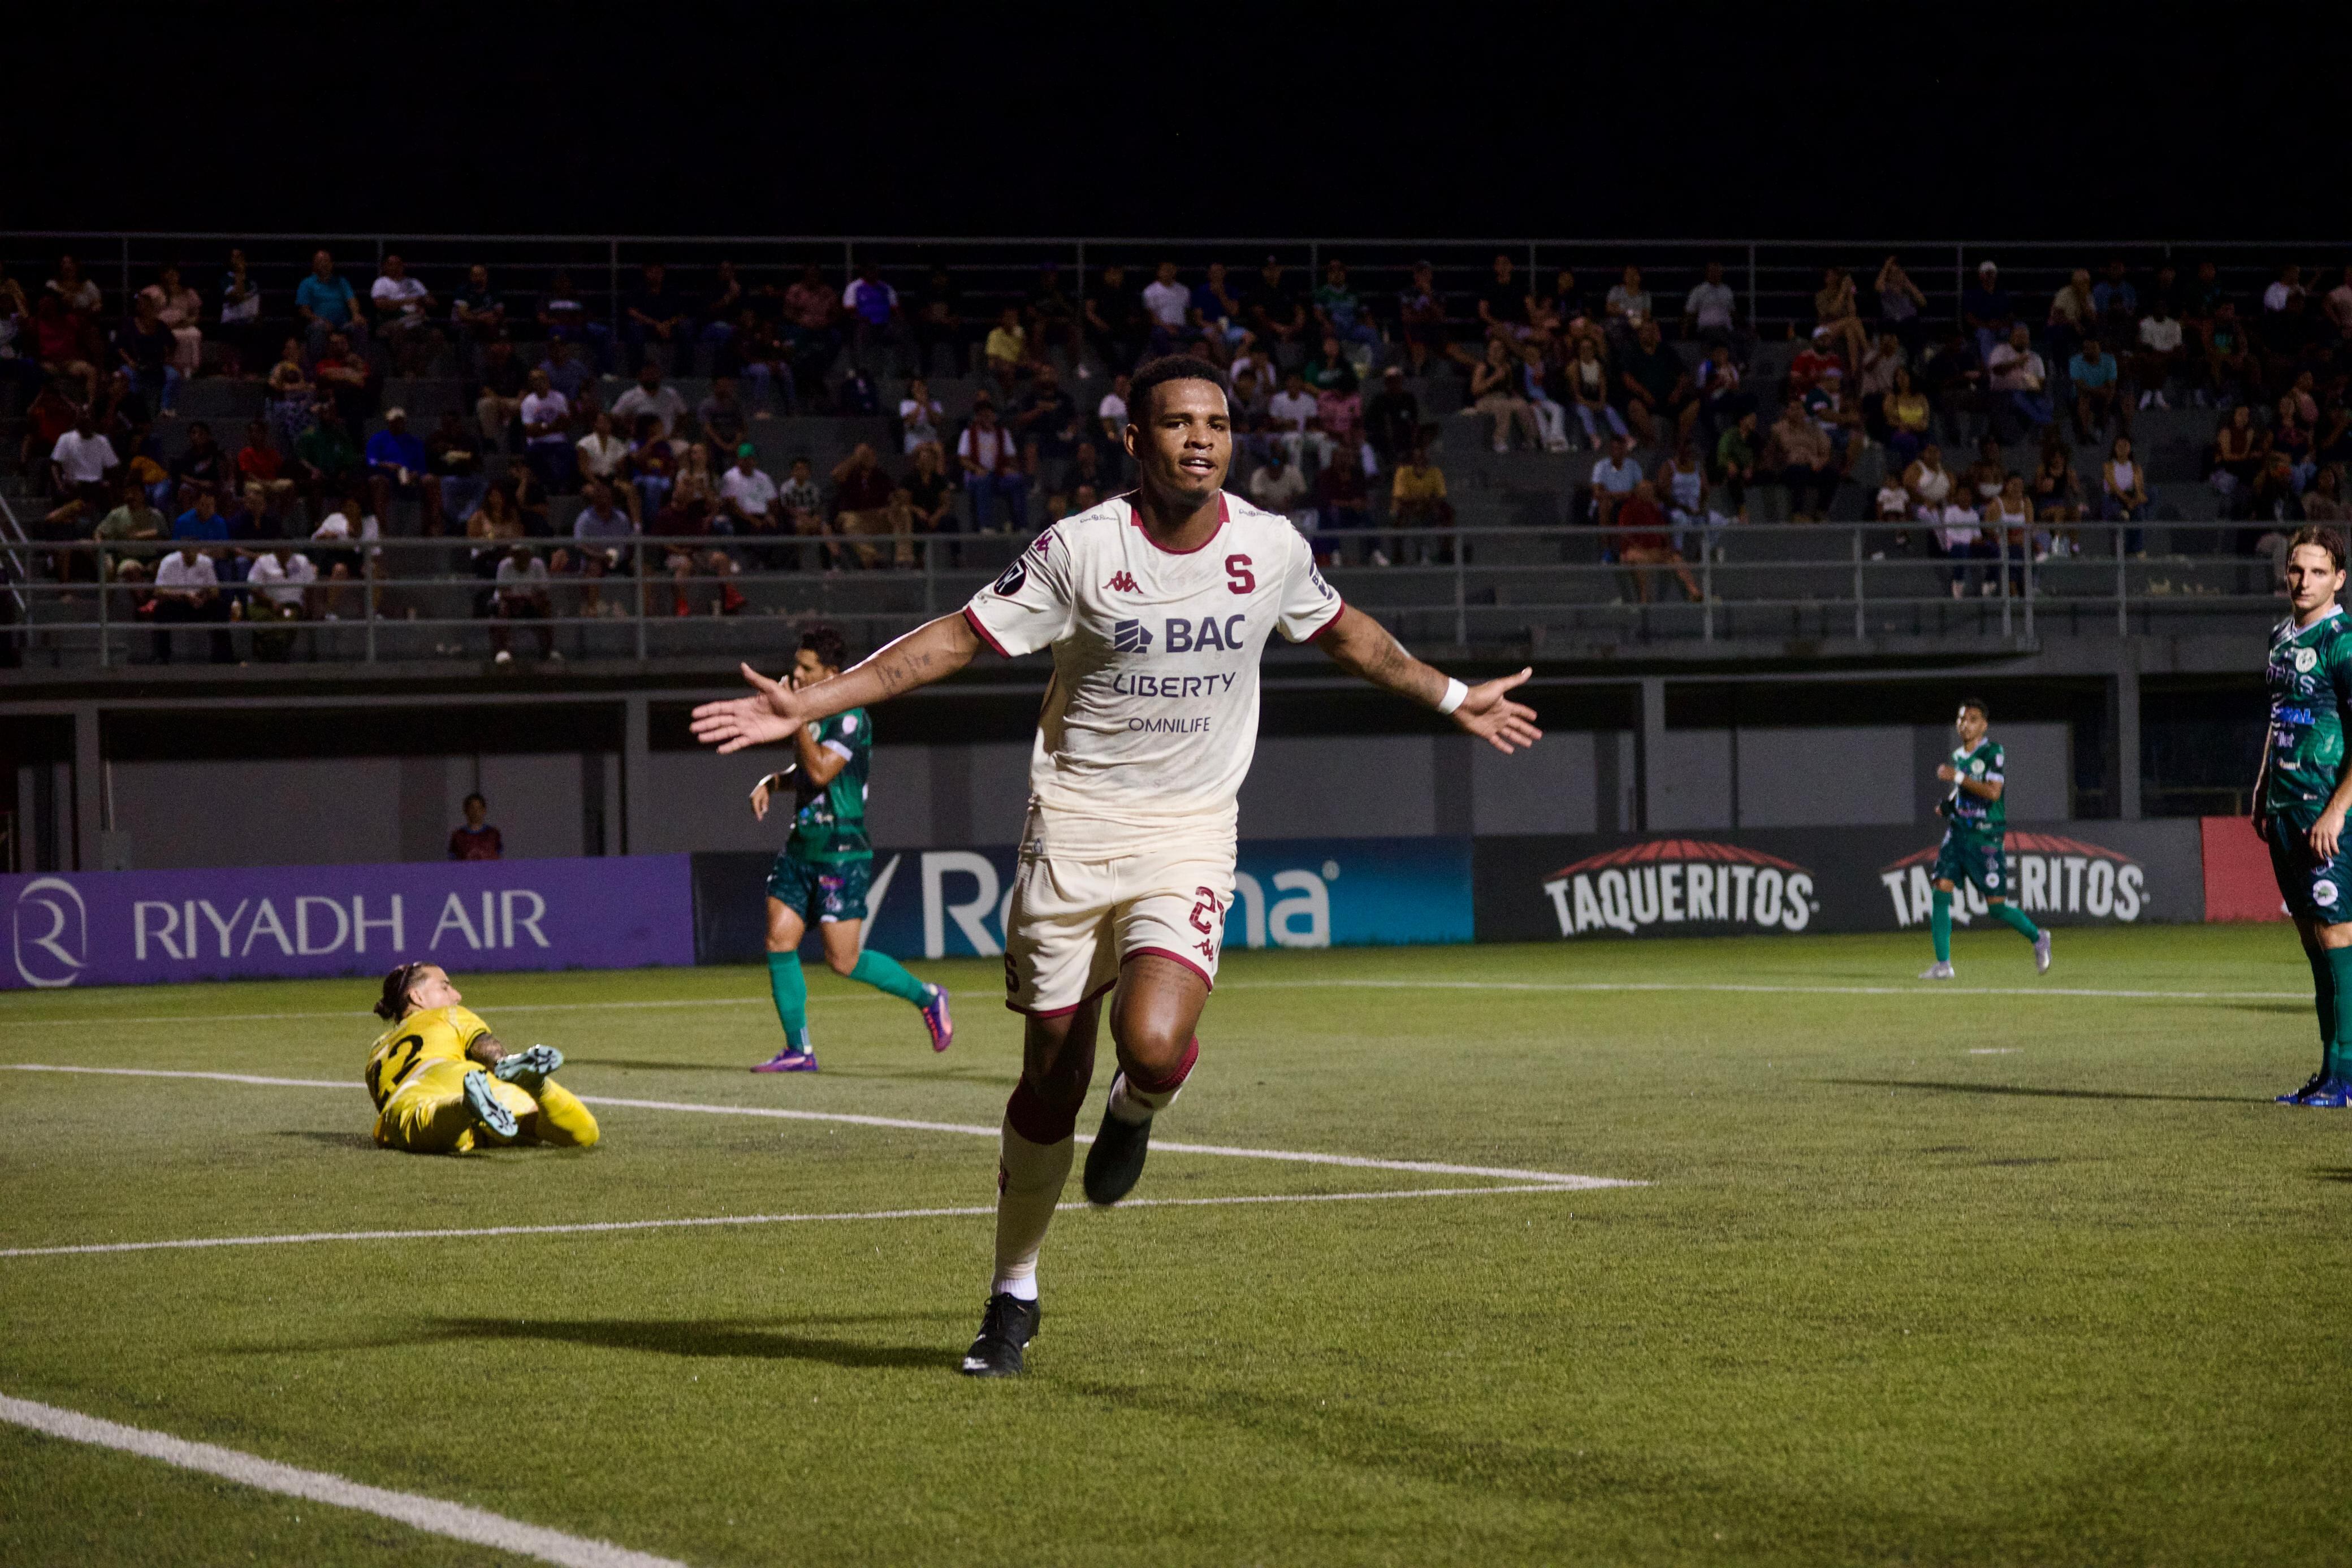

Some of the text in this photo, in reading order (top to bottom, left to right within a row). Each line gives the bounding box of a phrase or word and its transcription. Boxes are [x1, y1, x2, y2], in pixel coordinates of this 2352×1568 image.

[1225, 554, 1256, 595] S
[1165, 614, 1246, 653] BAC
[1113, 671, 1236, 698] LIBERTY
[1129, 717, 1212, 733] OMNILIFE
[1544, 863, 1813, 937] TAQUERITOS
[133, 889, 551, 960] RIYADH AIR
